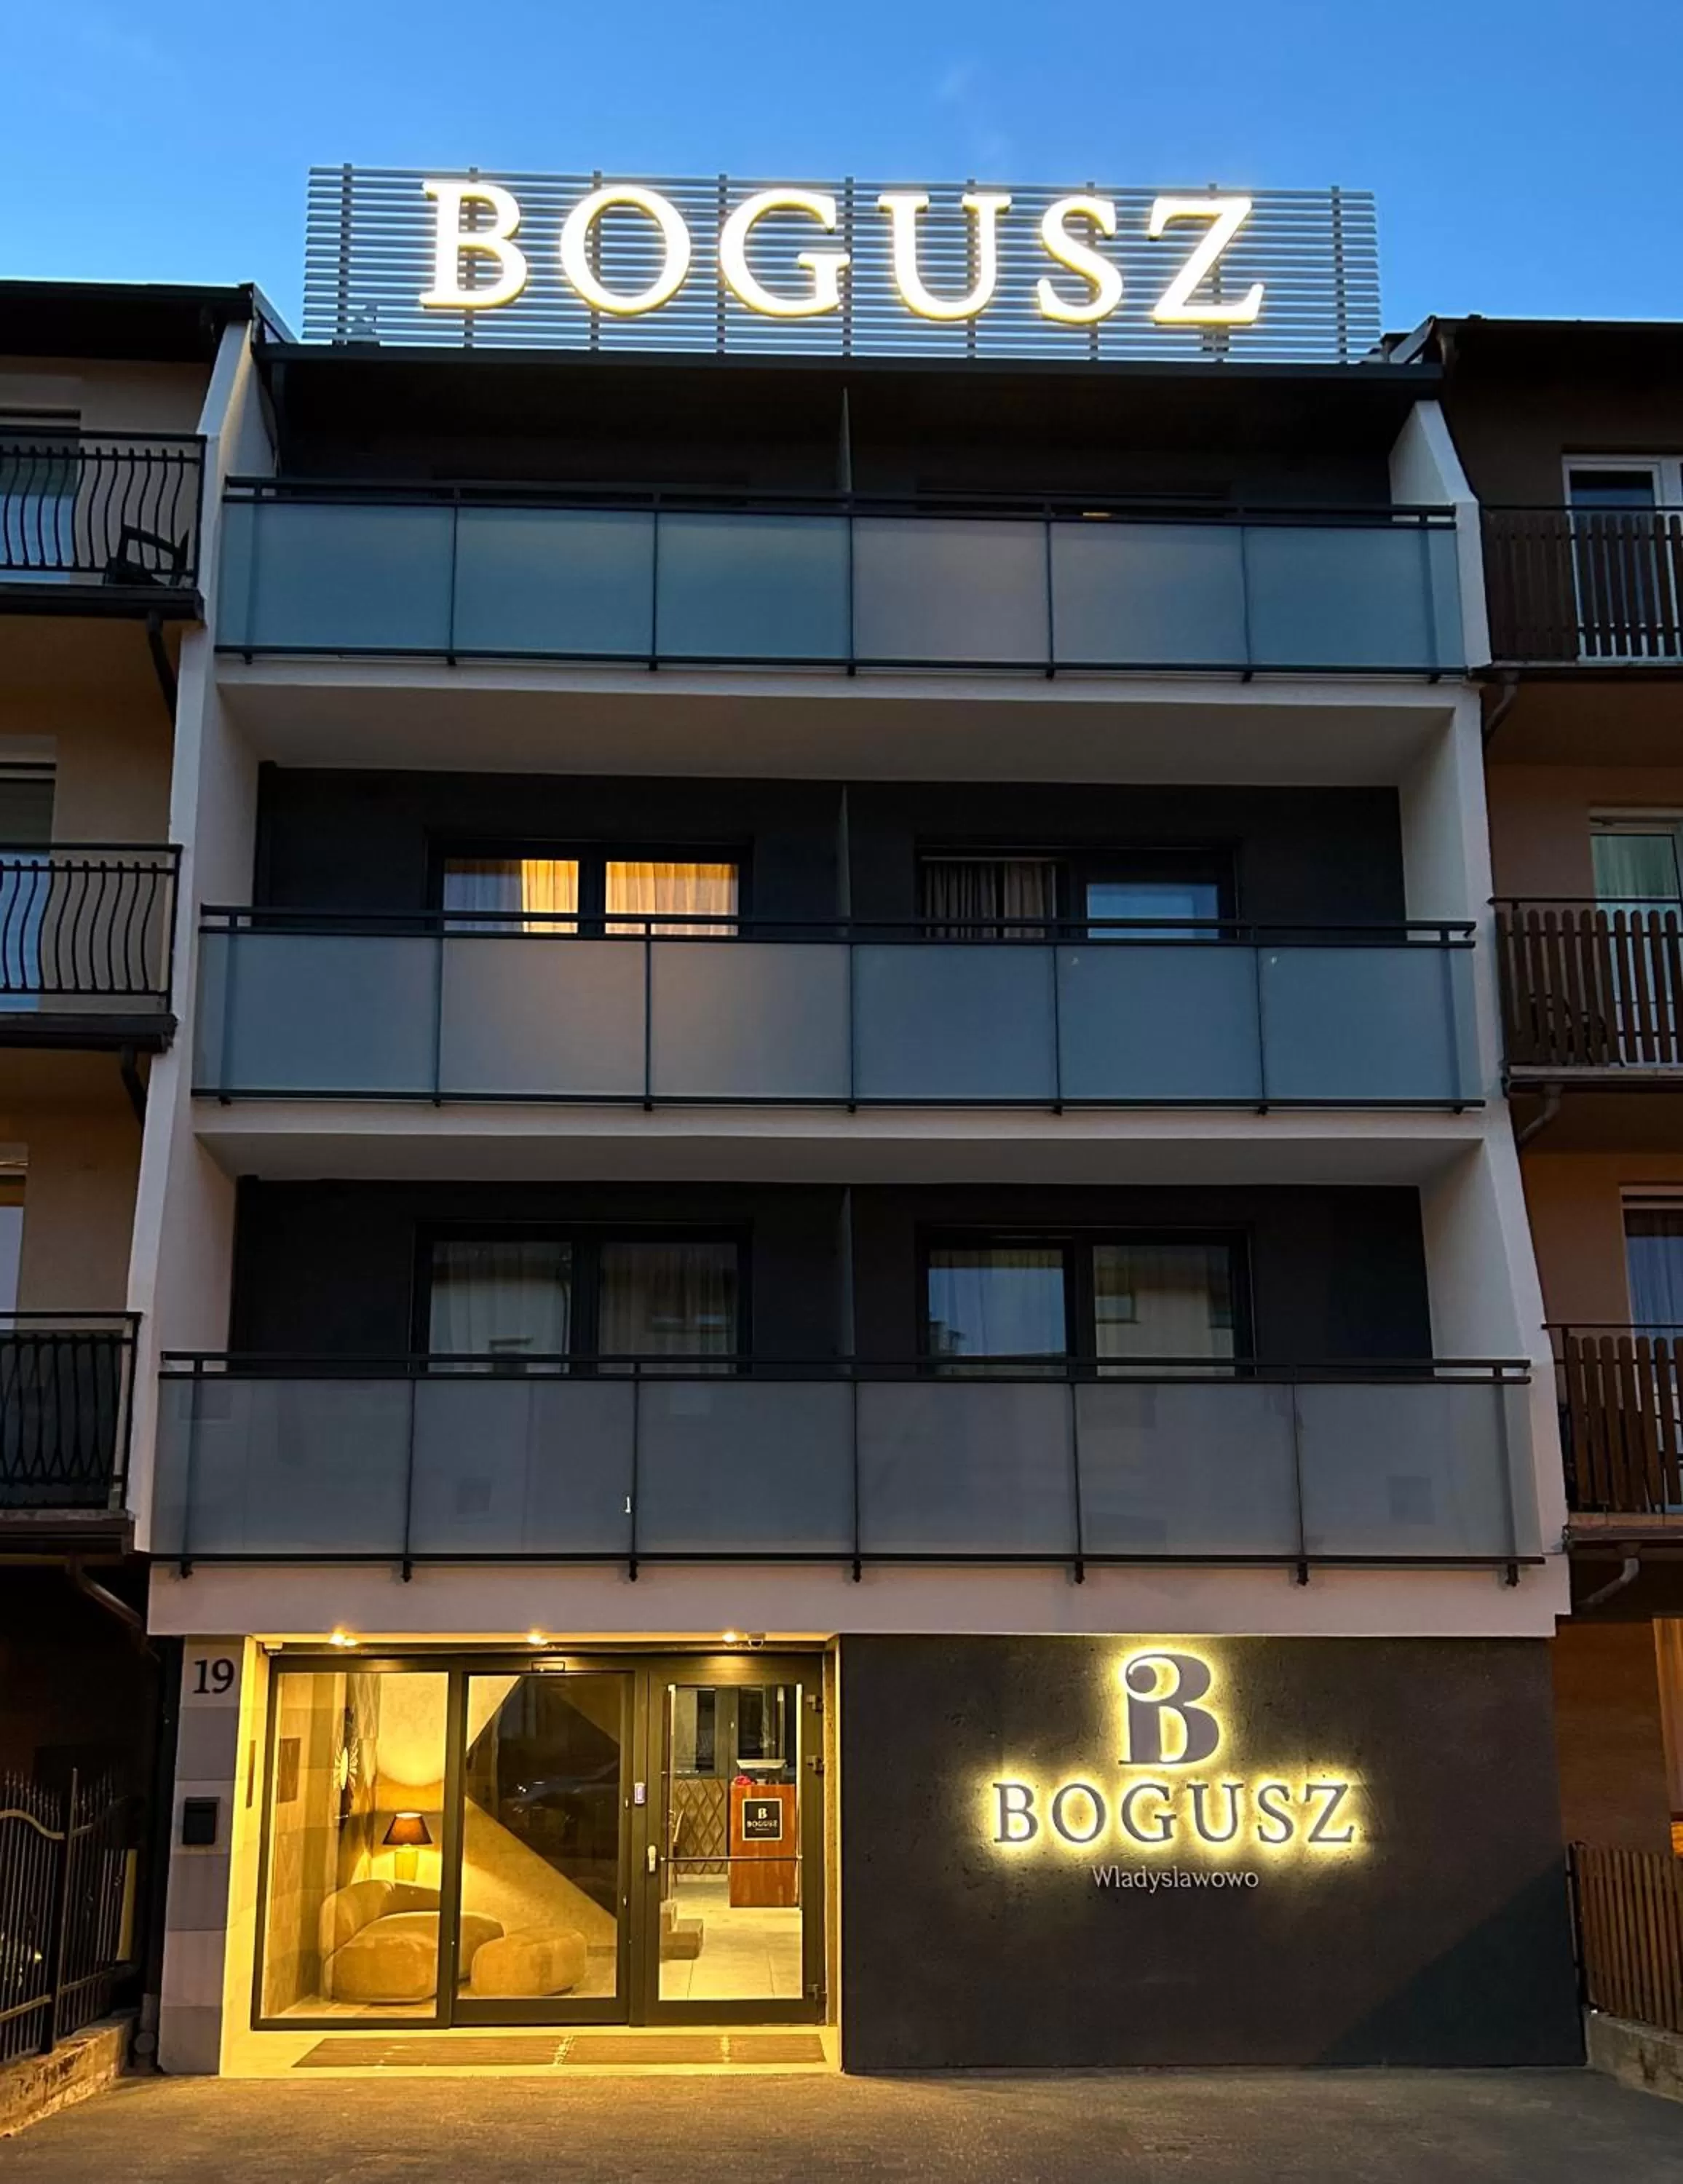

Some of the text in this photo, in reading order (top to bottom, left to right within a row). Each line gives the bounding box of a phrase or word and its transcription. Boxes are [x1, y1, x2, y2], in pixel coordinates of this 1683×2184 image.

[420, 181, 1265, 325] BOGUSZ
[193, 1658, 234, 1694] 19
[1119, 1653, 1220, 1765] B
[993, 1784, 1355, 1843] BOGUSZ
[1091, 1865, 1259, 1893] Wladyslawowo
